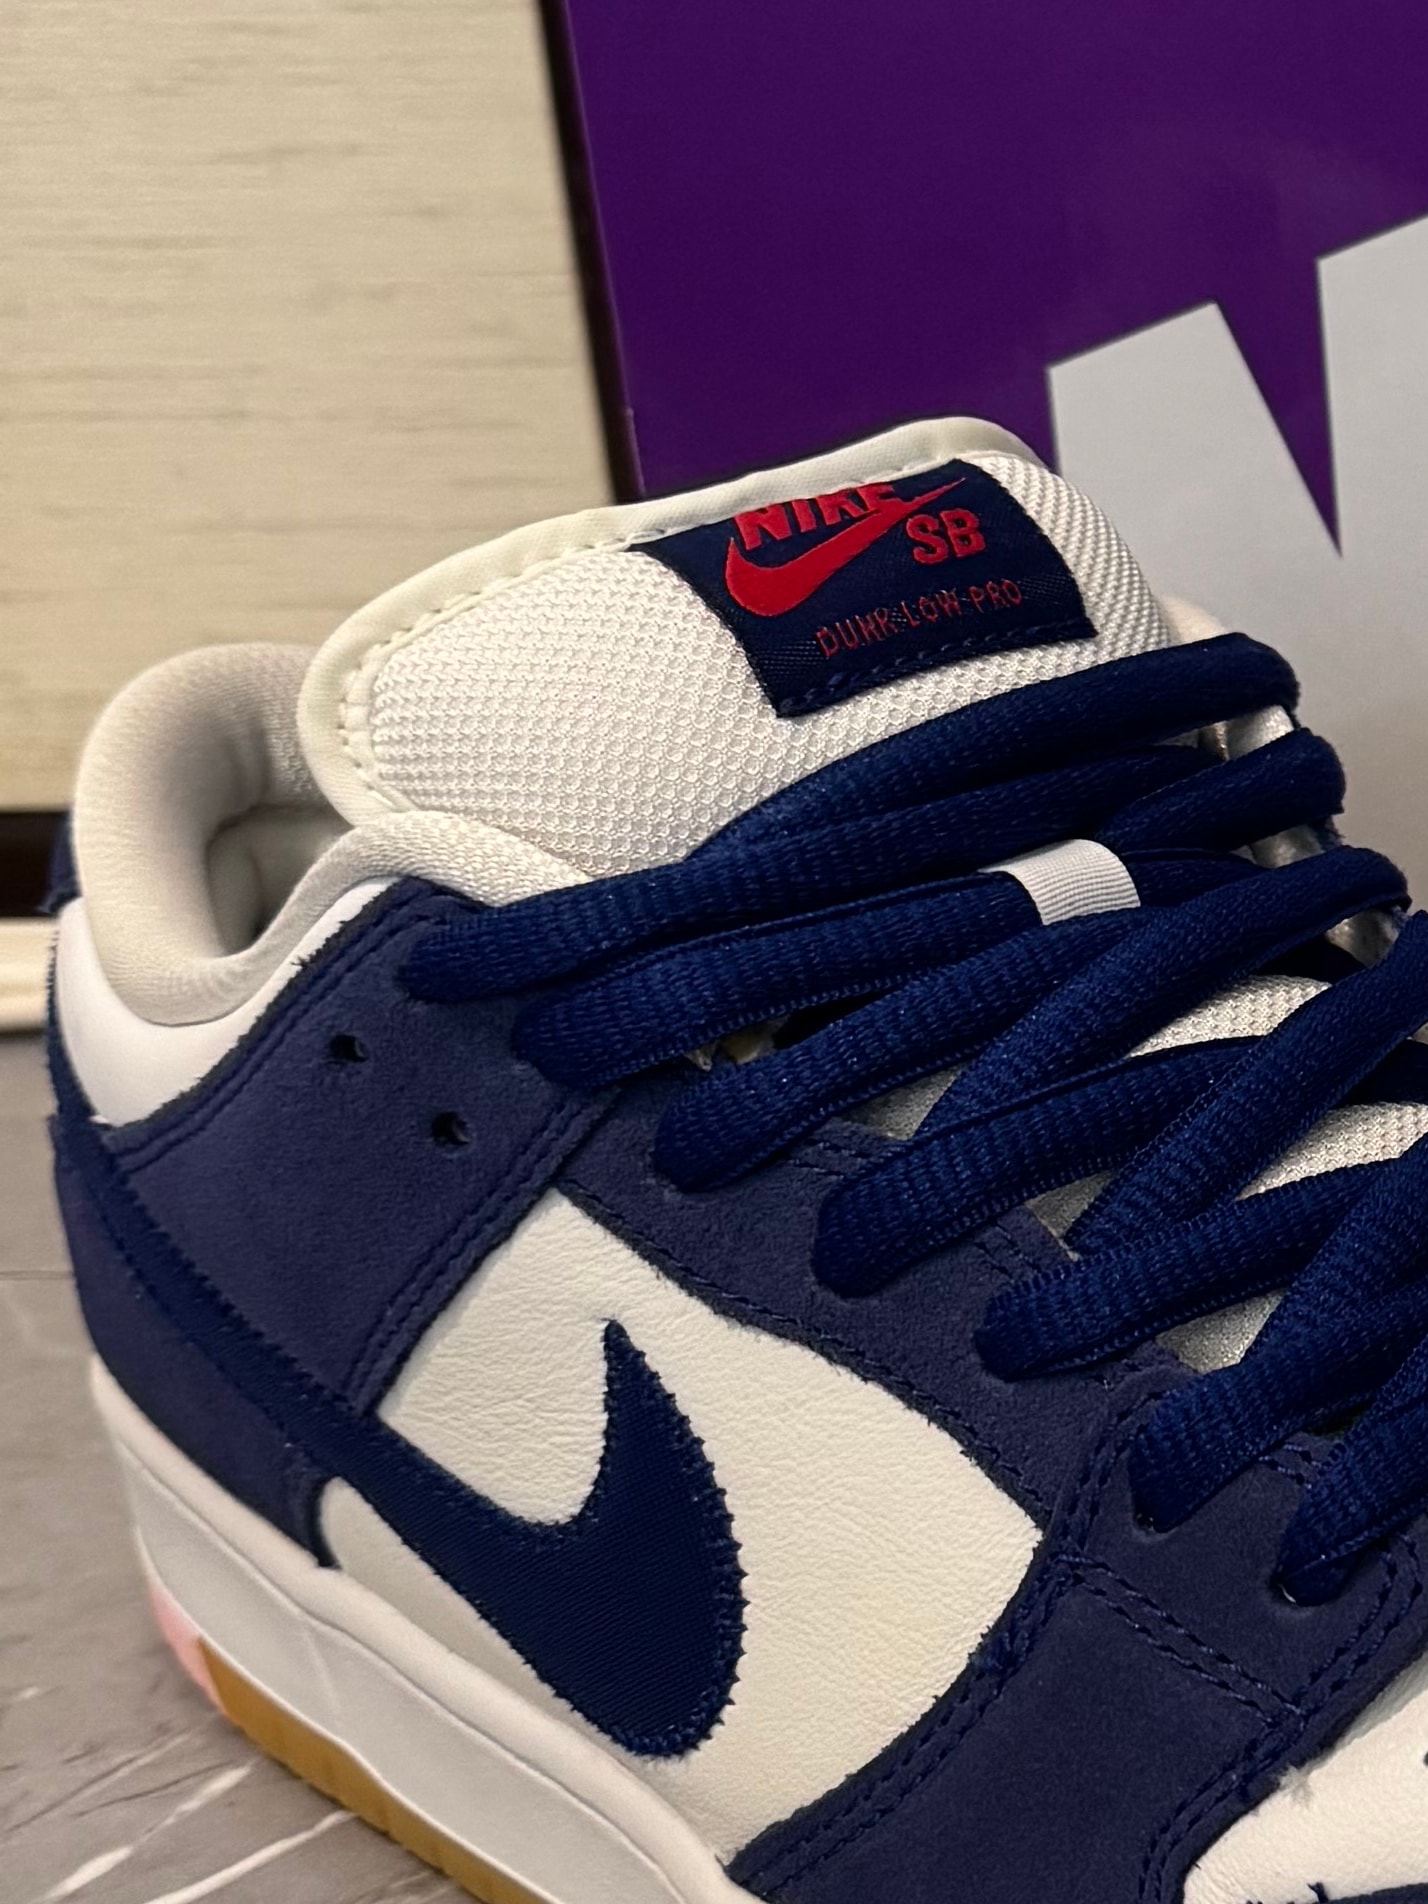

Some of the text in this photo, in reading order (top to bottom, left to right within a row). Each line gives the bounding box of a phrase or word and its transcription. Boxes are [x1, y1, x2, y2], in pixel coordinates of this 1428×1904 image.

[733, 483, 900, 551] NIKE
[904, 508, 987, 564] SB
[902, 589, 964, 626] LOW
[970, 580, 1023, 614] PRO
